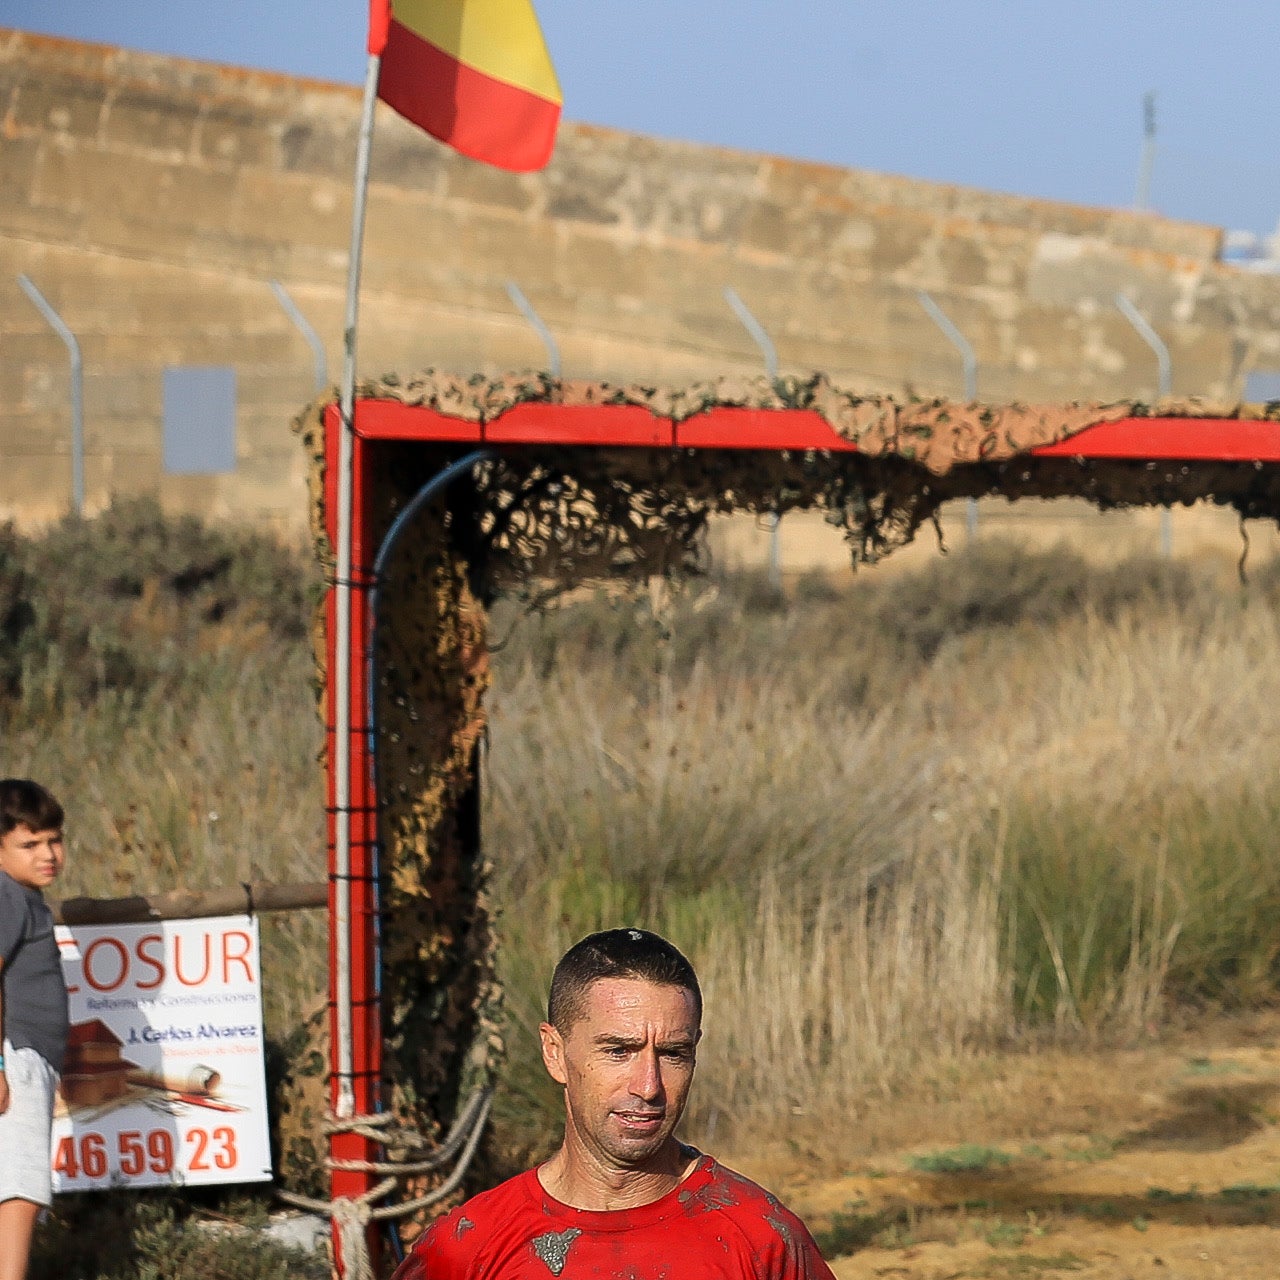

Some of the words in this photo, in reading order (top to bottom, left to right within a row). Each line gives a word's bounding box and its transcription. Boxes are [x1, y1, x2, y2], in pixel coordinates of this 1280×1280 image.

[57, 931, 255, 992] OSUR
[142, 1024, 192, 1043] Carlos
[53, 1132, 108, 1179] 46
[118, 1129, 175, 1176] 59
[186, 1127, 238, 1171] 23
